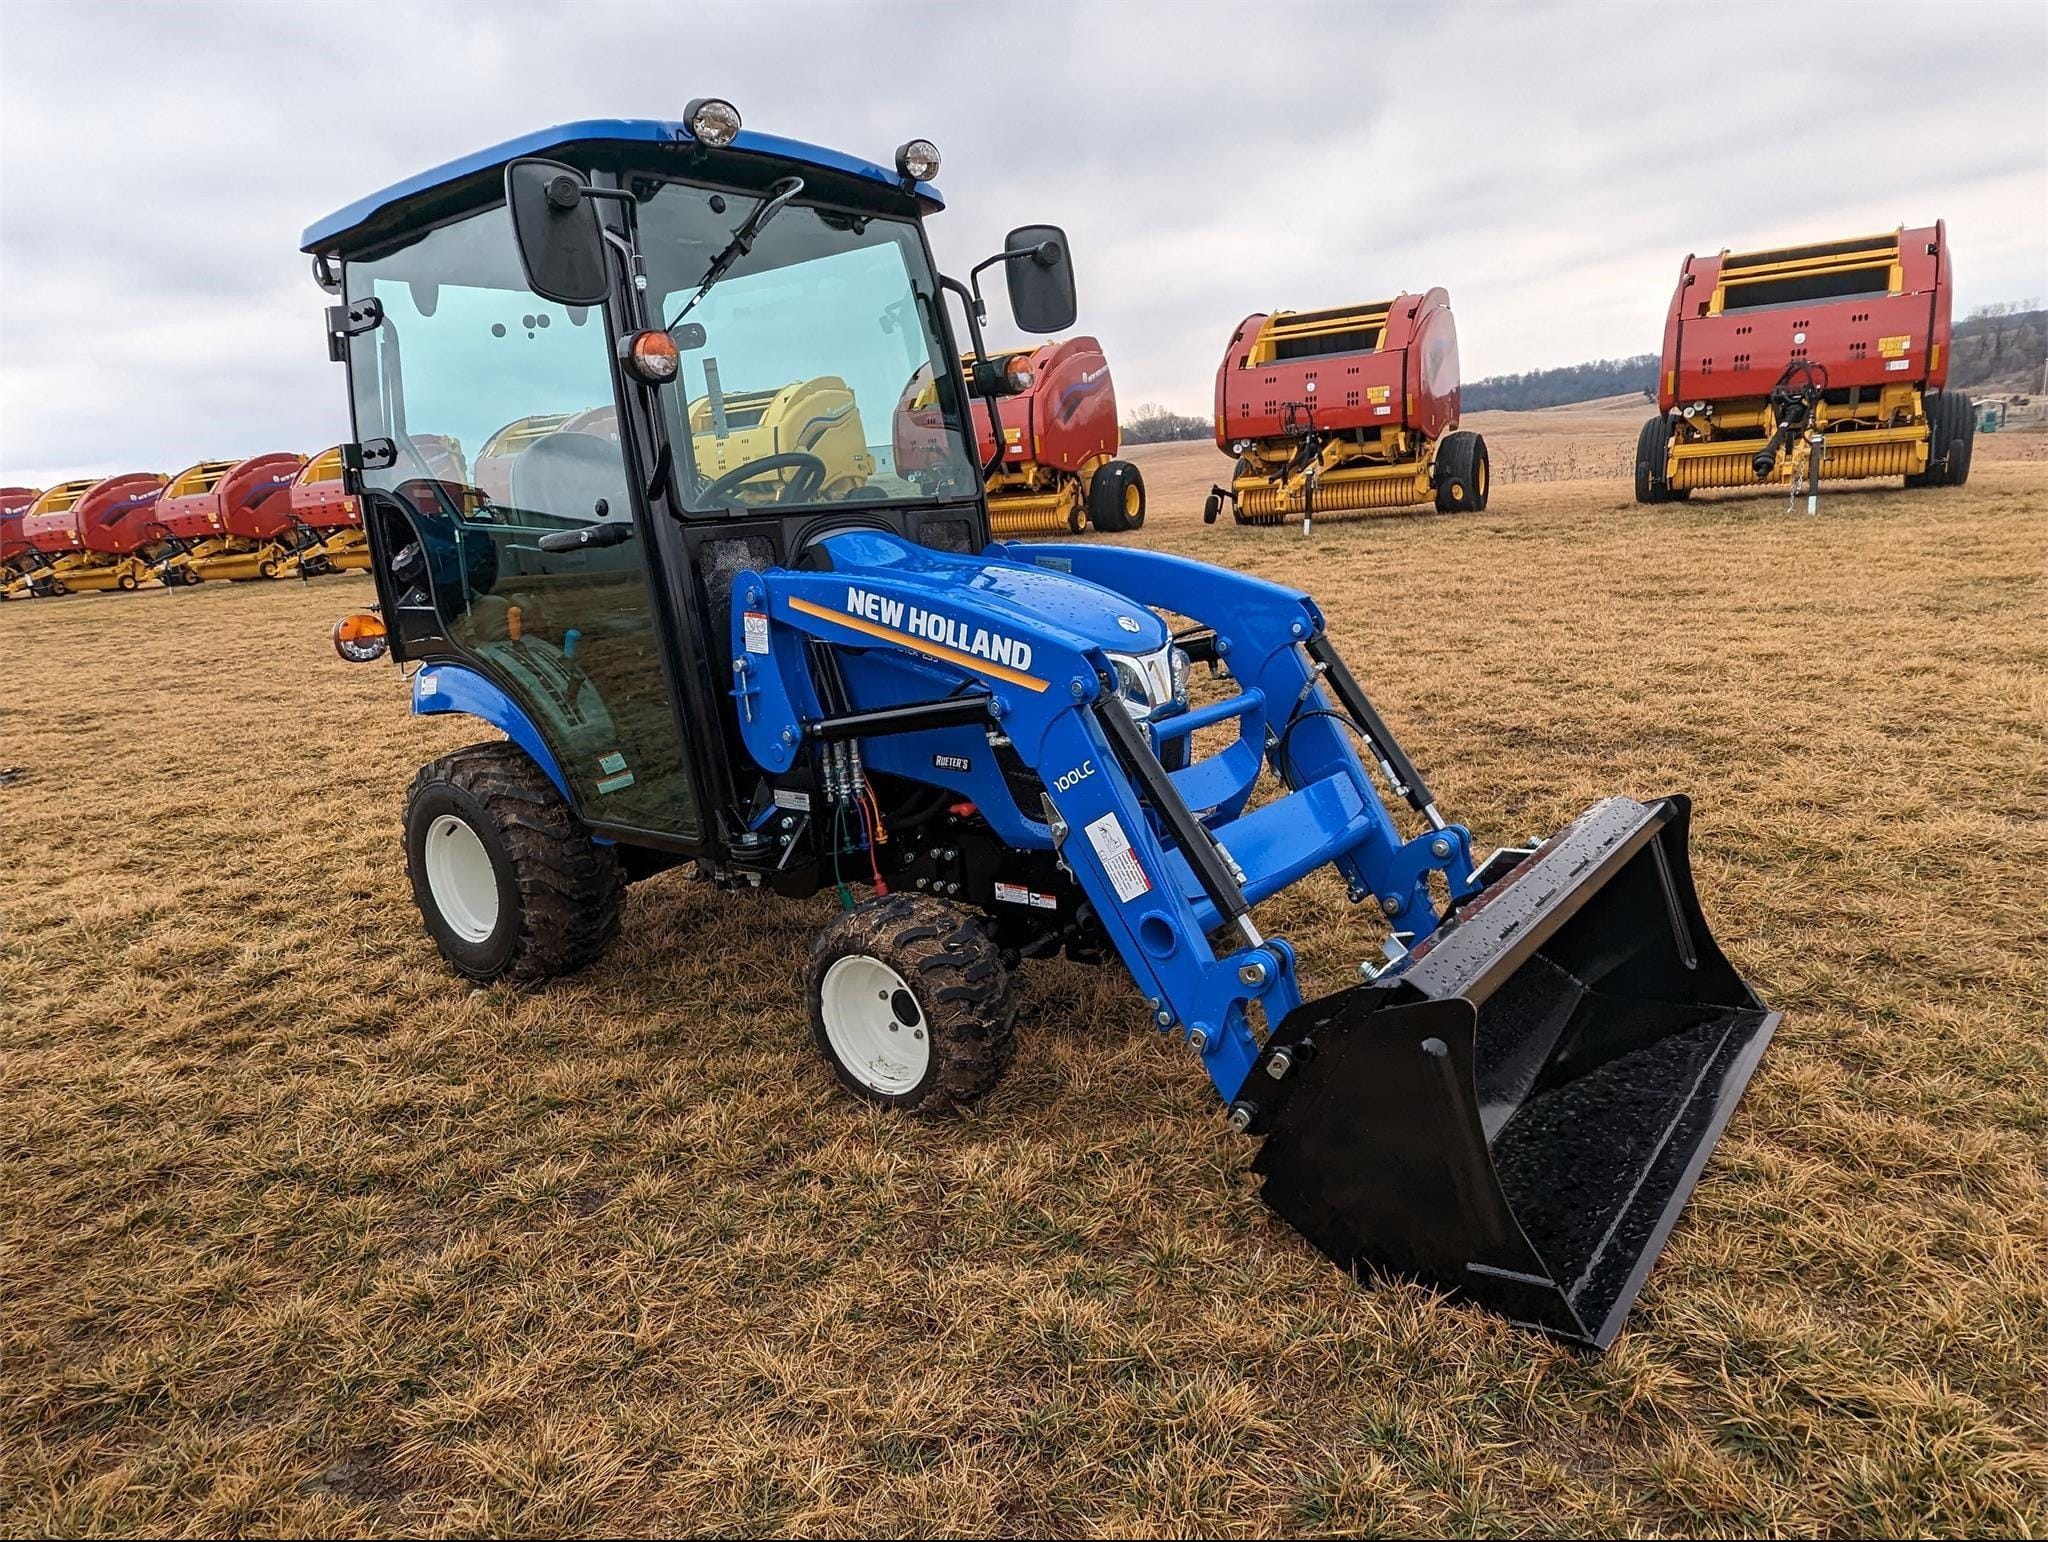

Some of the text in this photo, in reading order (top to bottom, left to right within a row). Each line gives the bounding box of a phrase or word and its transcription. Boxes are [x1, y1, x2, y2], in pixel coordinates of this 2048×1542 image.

[847, 587, 1032, 671] NEW HOLLAND
[1053, 760, 1095, 793] 100LC
